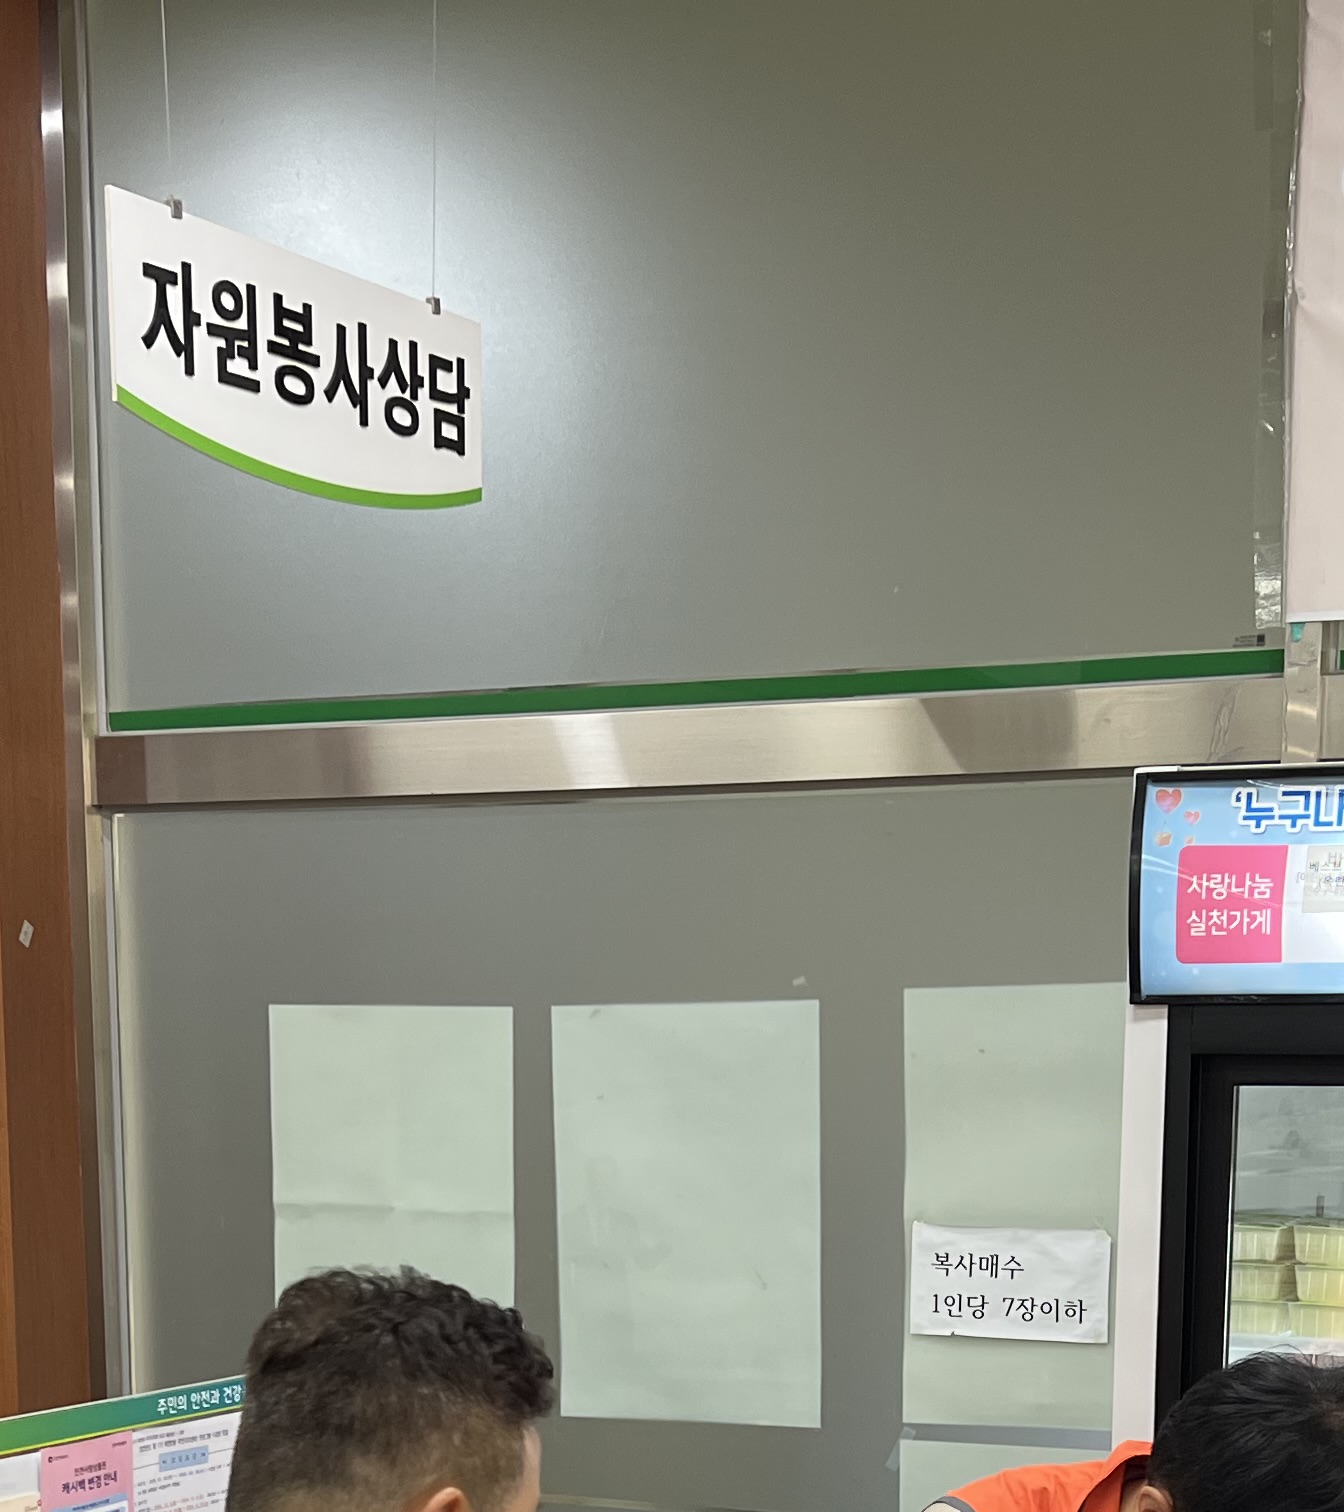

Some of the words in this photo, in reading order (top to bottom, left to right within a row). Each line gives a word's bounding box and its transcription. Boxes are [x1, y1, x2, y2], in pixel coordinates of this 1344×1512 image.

[141, 260, 471, 457] 자원봉사상담
[1186, 872, 1274, 899] 사랑나눔
[1186, 908, 1272, 938] 실천가게
[930, 1251, 1026, 1281] 복사매수
[930, 1292, 989, 1323] 1인당
[1002, 1295, 1088, 1326] 7장이하
[156, 1394, 188, 1415] 주민의
[190, 1388, 220, 1410] 안전과
